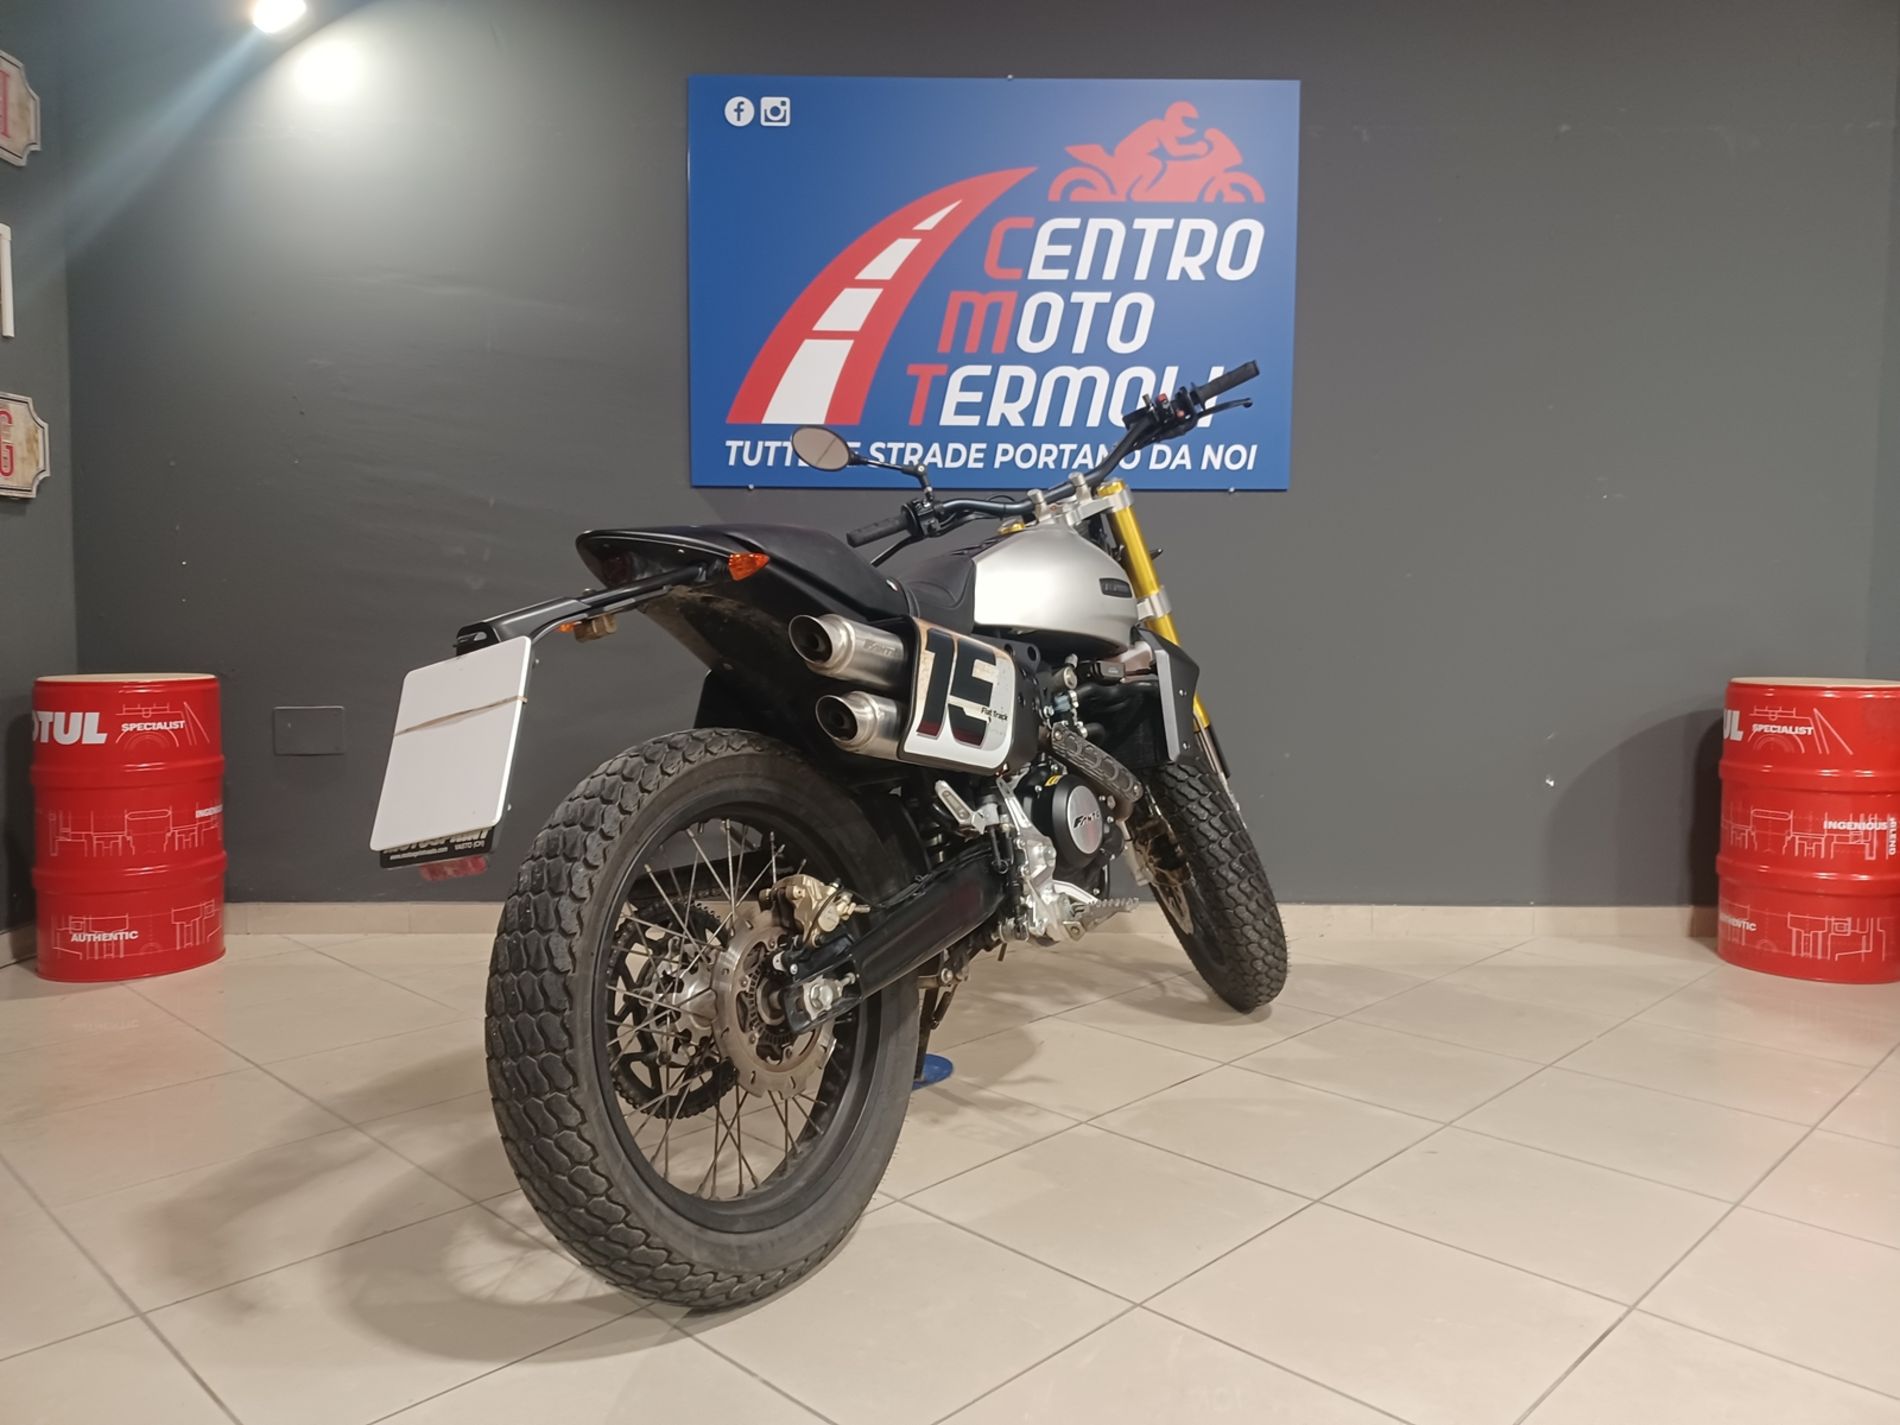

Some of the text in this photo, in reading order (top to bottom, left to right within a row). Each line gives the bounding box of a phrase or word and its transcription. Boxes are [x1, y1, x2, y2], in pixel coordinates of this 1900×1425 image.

[983, 216, 1266, 281] CENTRO
[936, 290, 1156, 354] MOTO
[725, 440, 809, 467] TUTT
[869, 441, 987, 469] STRADE
[1148, 443, 1192, 470] DA
[1200, 443, 1258, 471] NOI
[32, 710, 108, 746] TUL
[121, 719, 186, 733] SPECIALIST
[1751, 722, 1815, 736] SPECIALIST
[70, 929, 139, 943] AUTHENTIC
